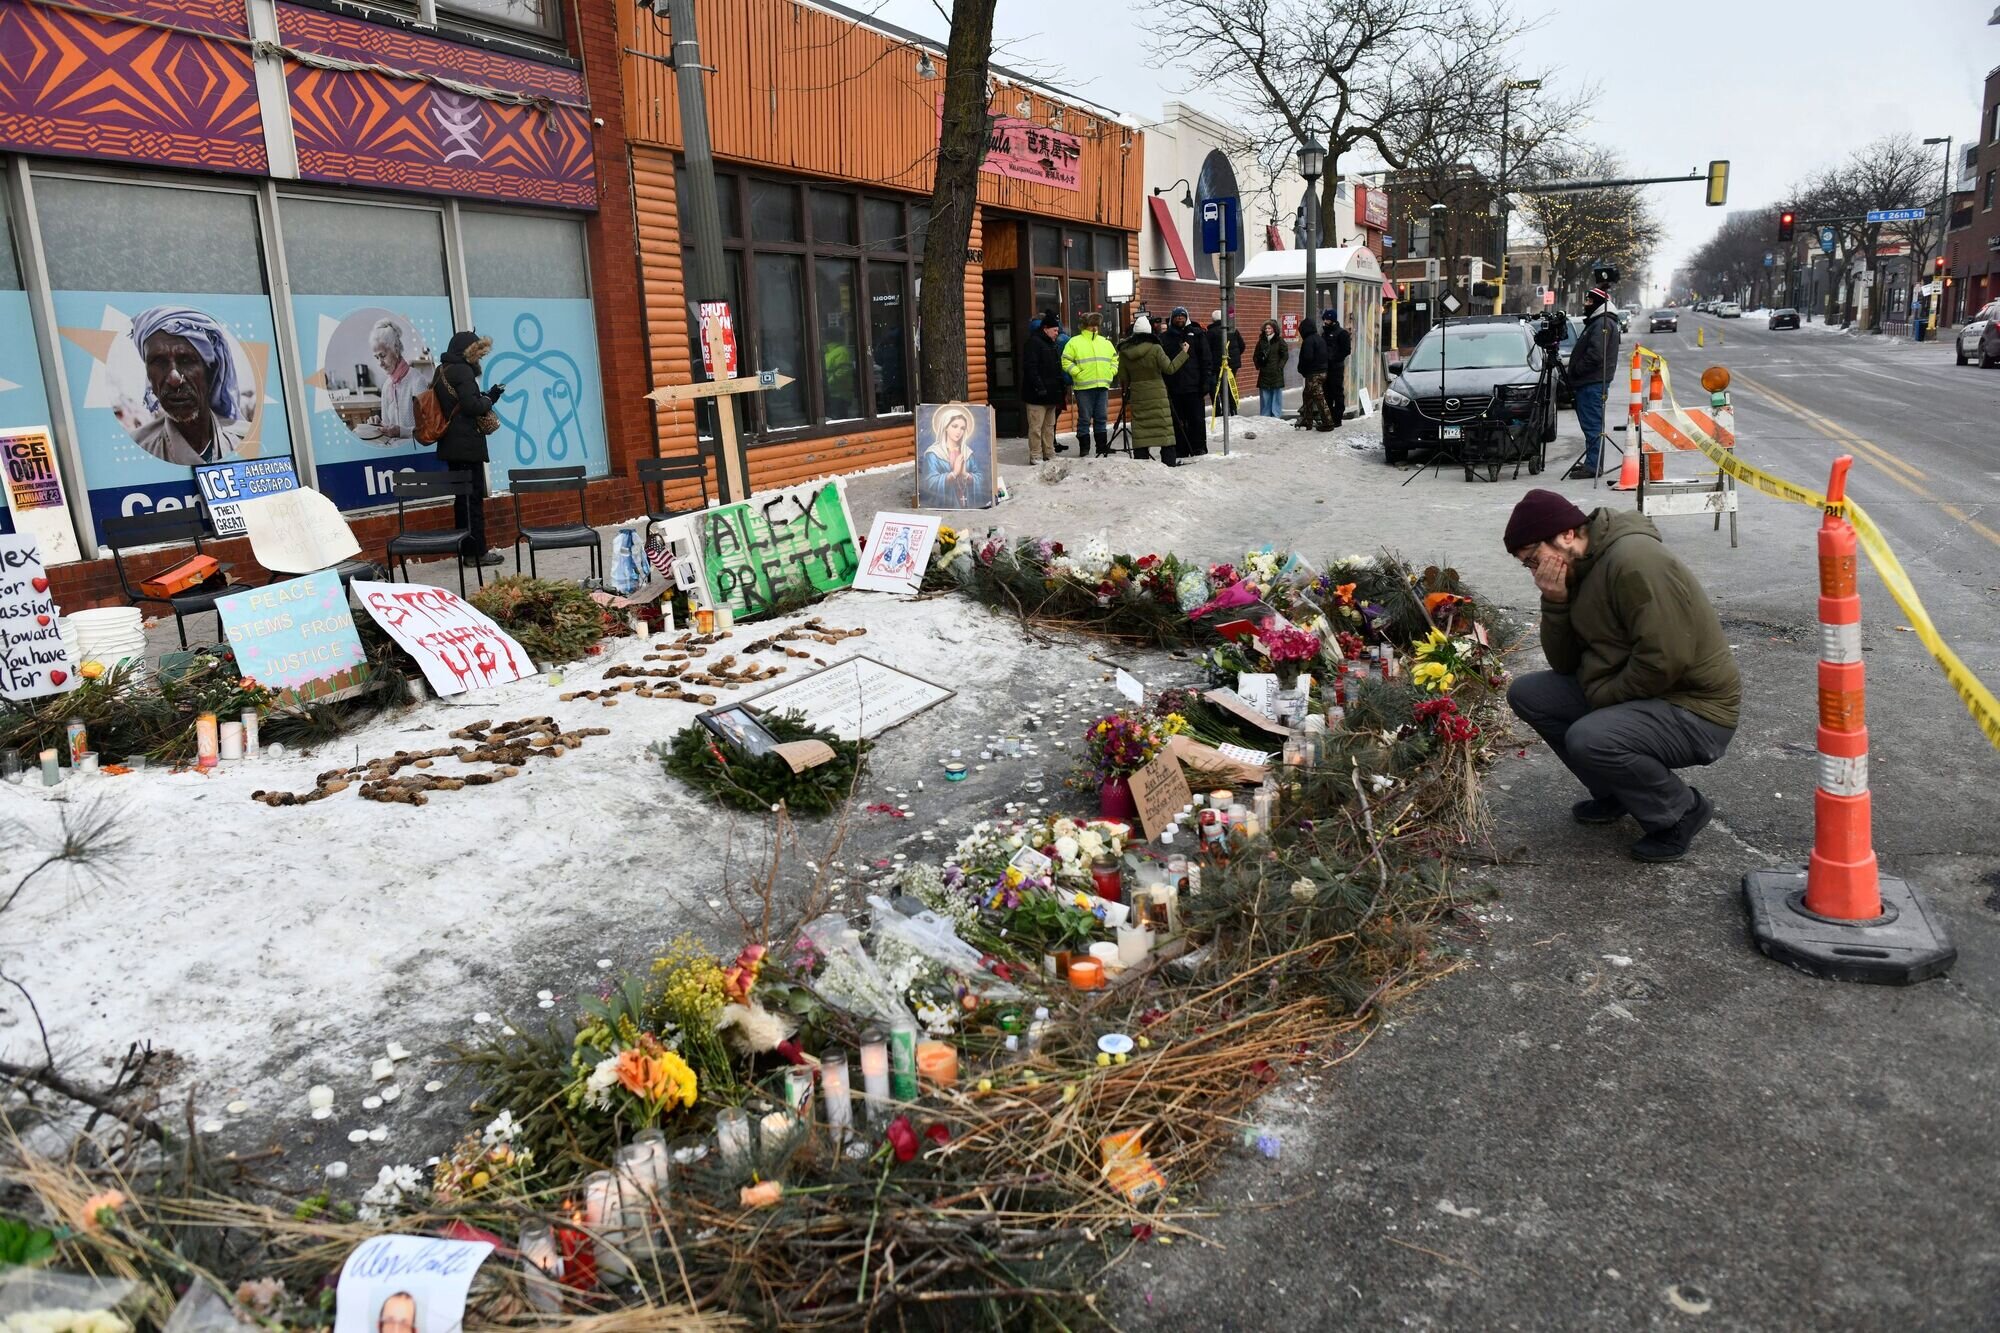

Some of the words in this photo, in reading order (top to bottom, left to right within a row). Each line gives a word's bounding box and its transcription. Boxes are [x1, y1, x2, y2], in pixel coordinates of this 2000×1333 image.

[1889, 211, 1910, 219] 26th
[700, 303, 726, 316] SHUT
[4, 442, 47, 459] ICE
[9, 457, 53, 482] OUT!
[198, 468, 240, 500] ICE
[244, 461, 293, 478] AMERICAN
[16, 491, 48, 504] JANUARY
[49, 489, 60, 500] 23
[248, 477, 293, 494] GESTAPO
[214, 505, 236, 517] THEY
[712, 491, 828, 557] ALEX
[717, 538, 860, 610] PRETTI
[251, 581, 318, 612] PEACE
[368, 588, 464, 628] STOP
[0, 619, 62, 649] toward
[228, 613, 294, 642] STEMS
[301, 614, 353, 641] FROM
[1, 648, 31, 670] You
[29, 645, 68, 666] have
[264, 641, 344, 677] JUSTICE
[10, 667, 41, 691] For
